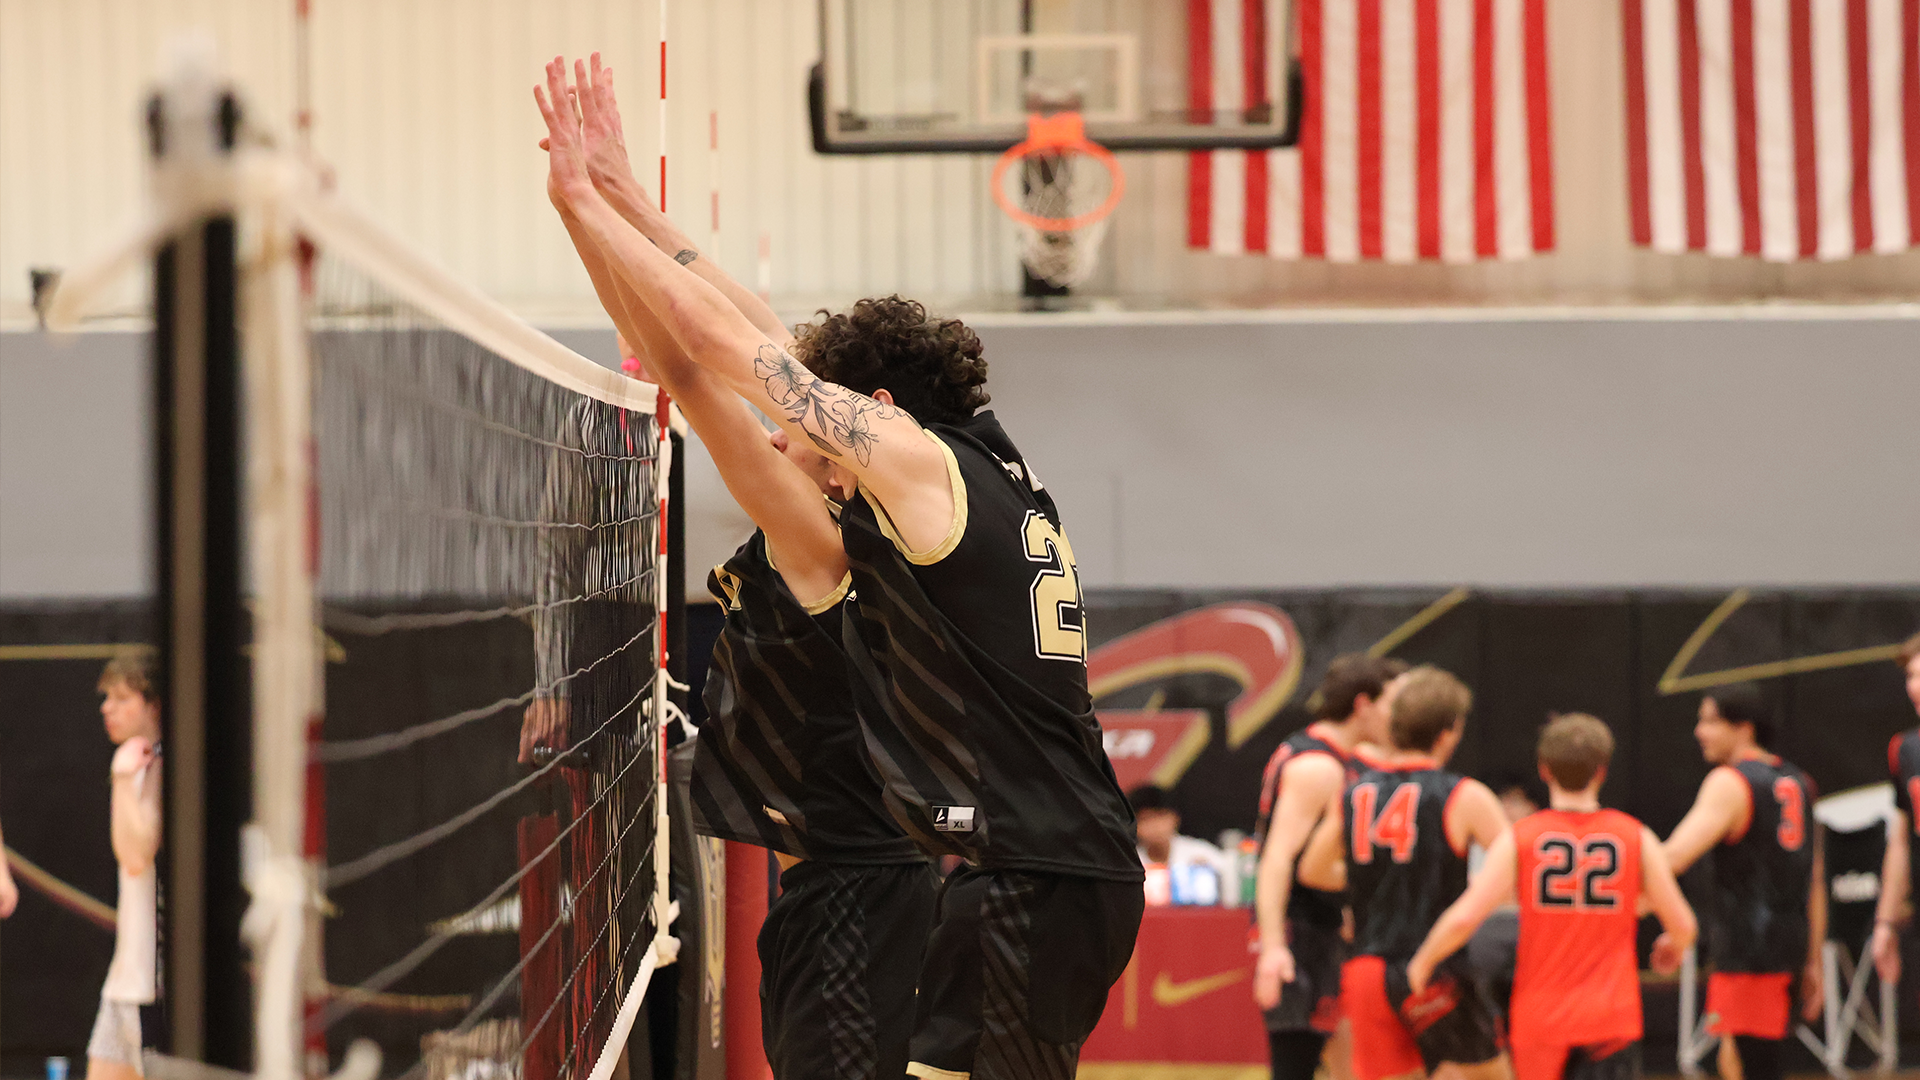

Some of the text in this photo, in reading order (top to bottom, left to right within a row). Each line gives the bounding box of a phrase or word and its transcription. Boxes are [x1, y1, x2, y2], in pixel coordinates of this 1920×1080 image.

[1020, 509, 1088, 667] 2
[953, 820, 966, 829] XL
[1351, 782, 1422, 864] 14
[1773, 776, 1805, 852] 3
[1532, 831, 1626, 914] 22
